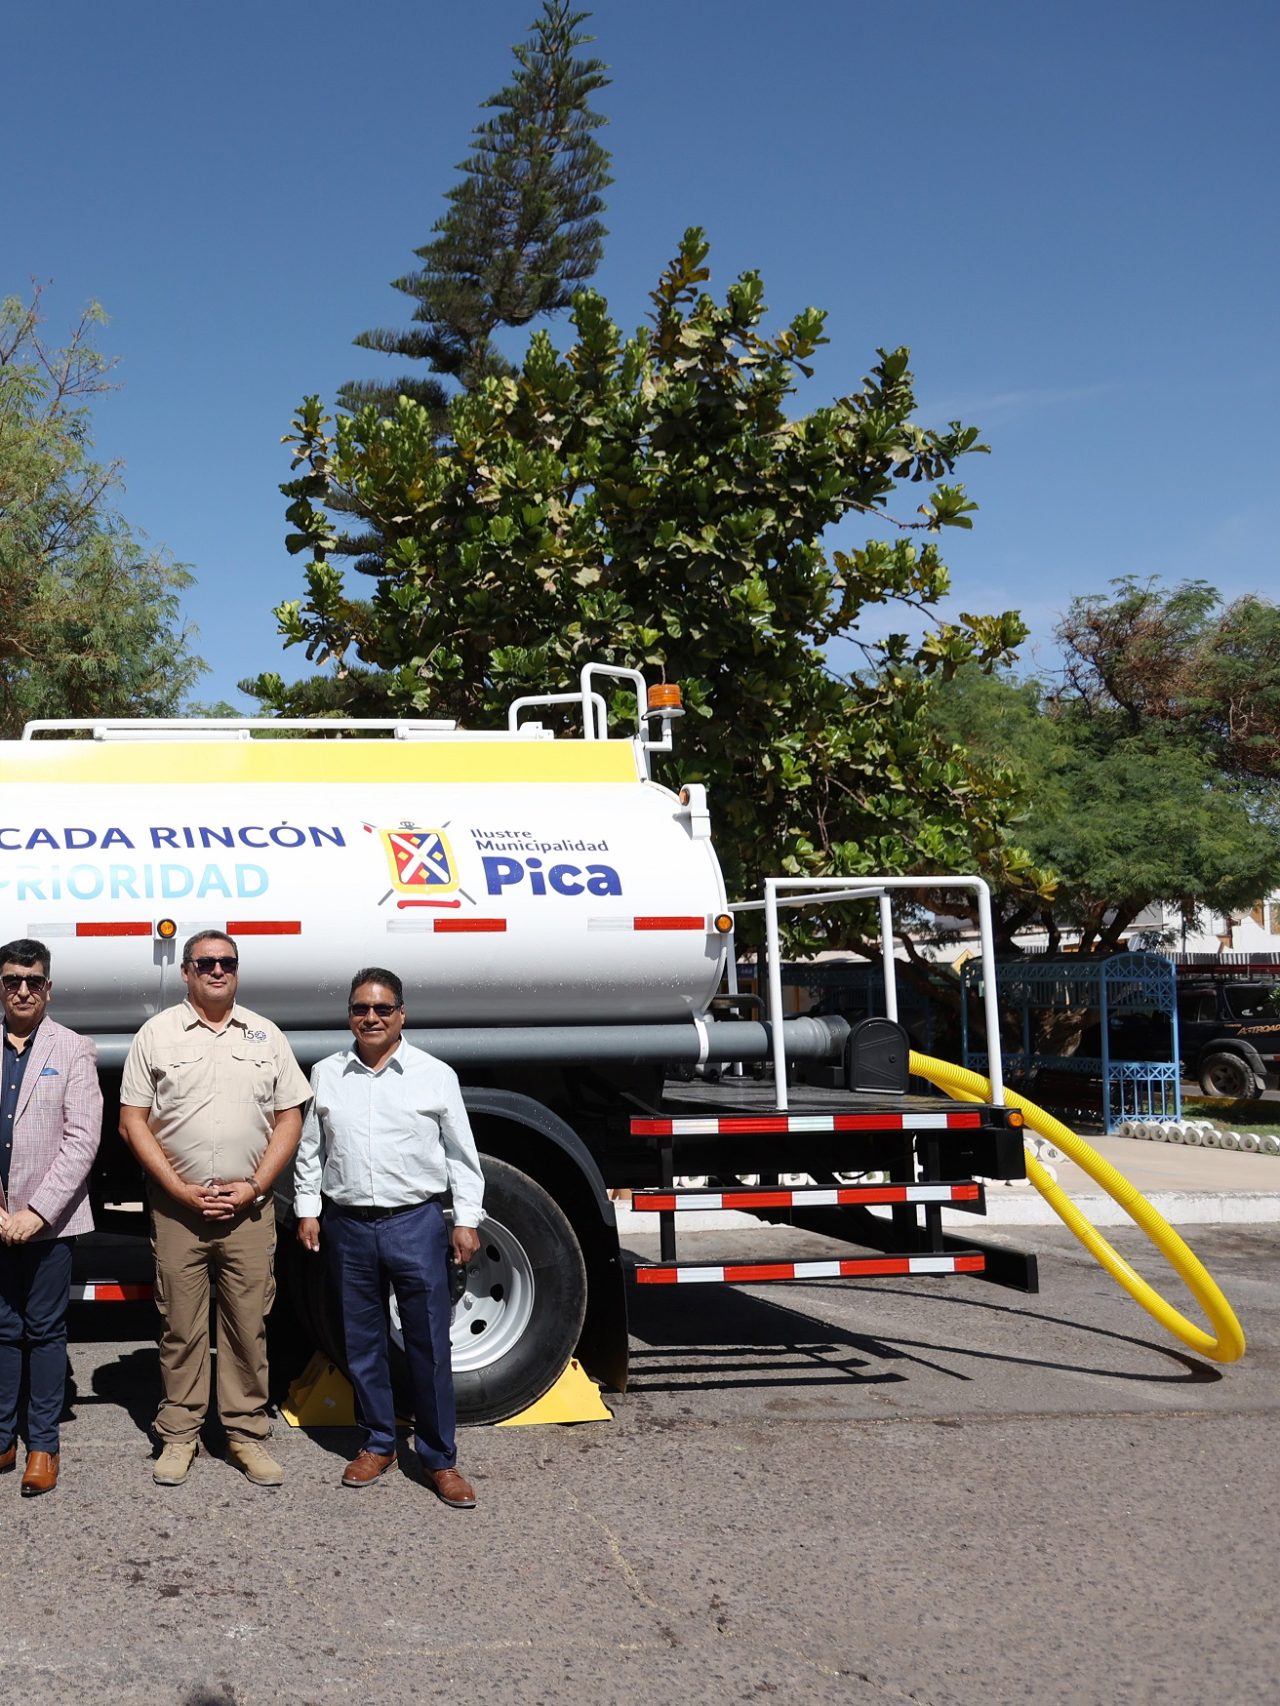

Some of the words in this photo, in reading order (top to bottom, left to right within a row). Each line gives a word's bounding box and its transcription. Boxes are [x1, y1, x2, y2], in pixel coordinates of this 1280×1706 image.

[149, 821, 346, 848] RINCÓN
[470, 829, 532, 838] Ilustre
[476, 840, 609, 853] Municipalidad
[481, 856, 623, 896] Pica
